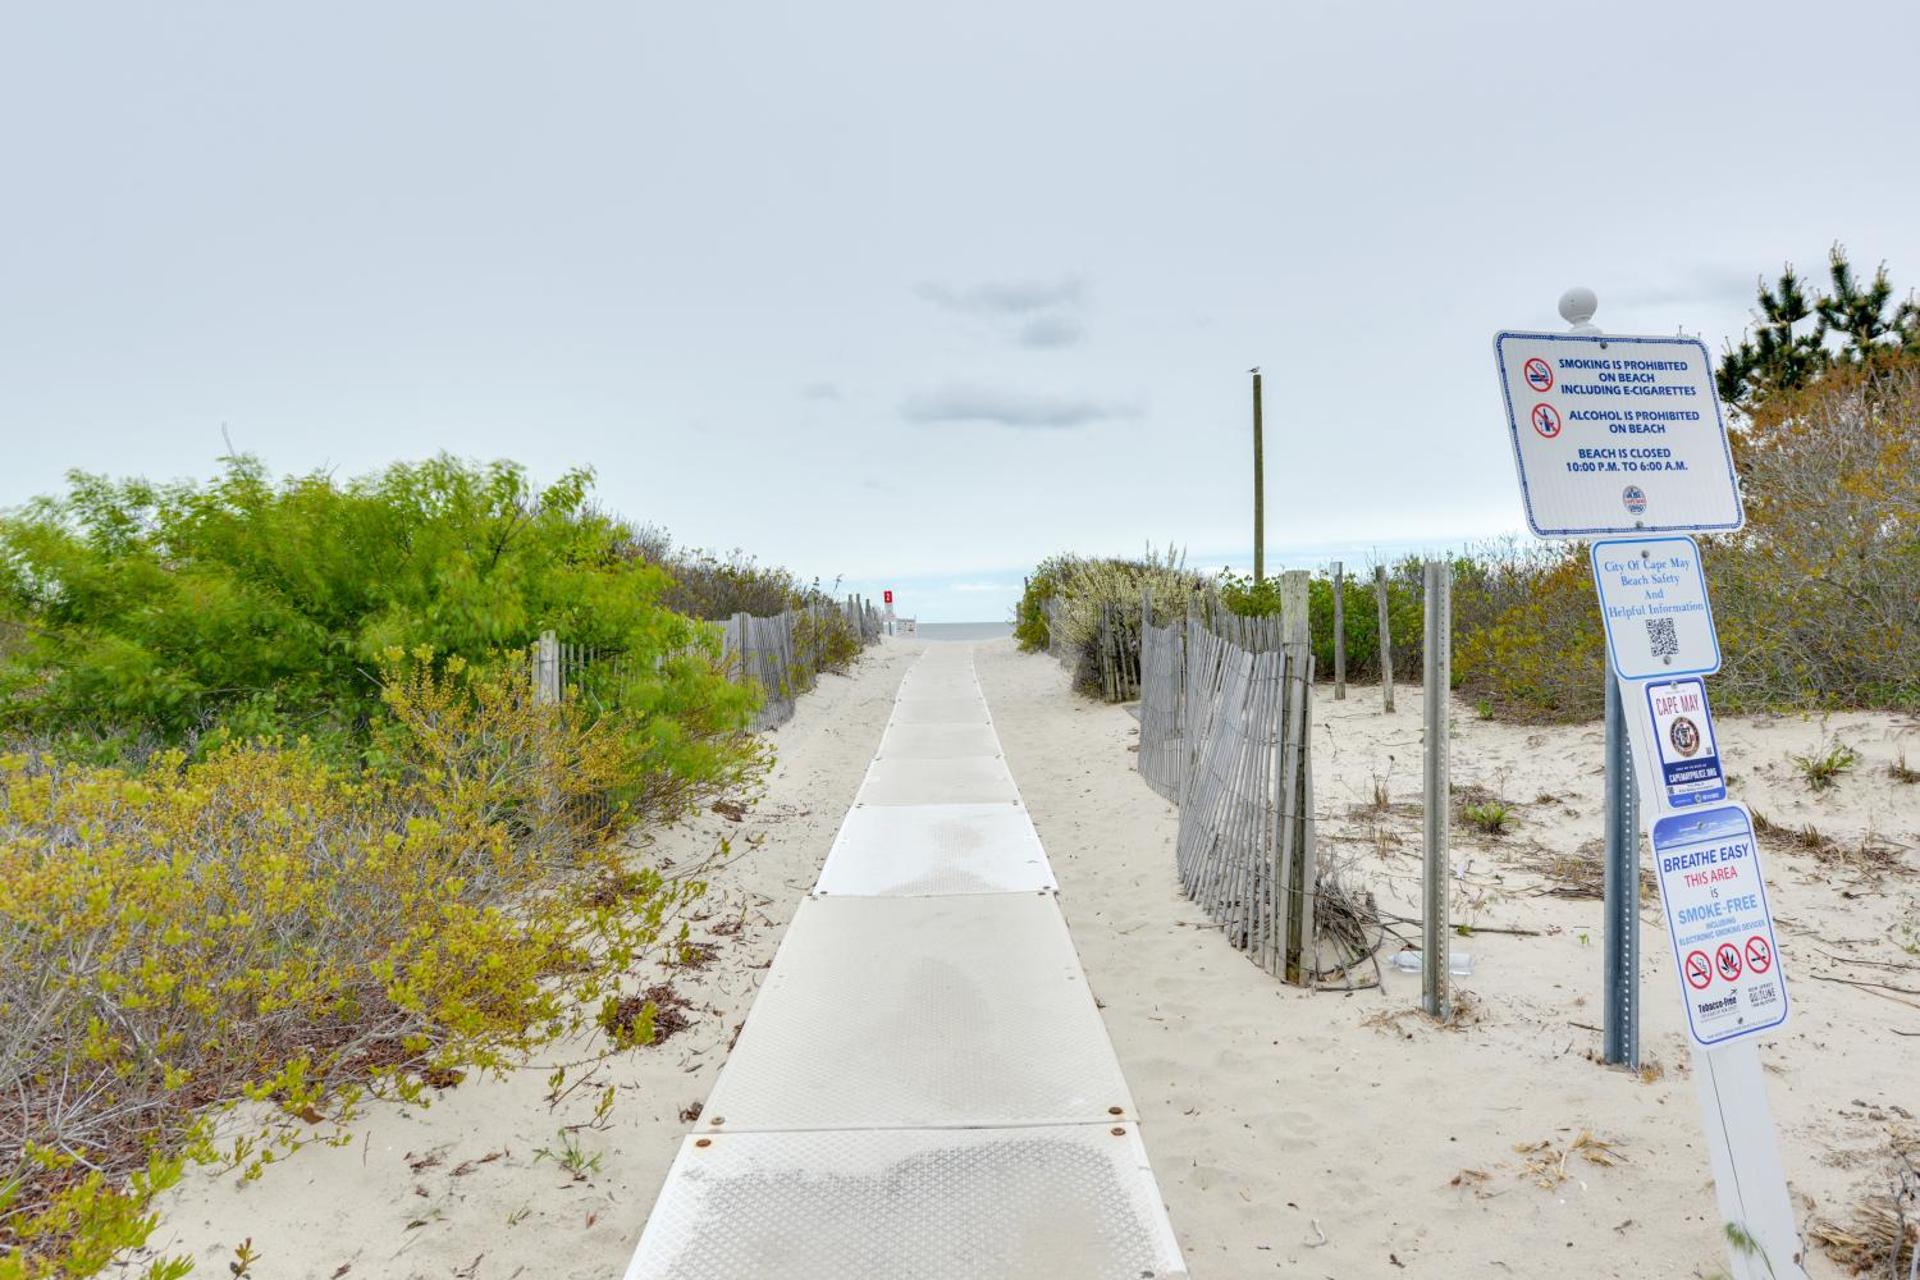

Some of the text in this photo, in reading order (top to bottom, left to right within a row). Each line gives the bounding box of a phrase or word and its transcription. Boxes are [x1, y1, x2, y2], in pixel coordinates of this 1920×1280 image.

[1559, 359, 1688, 371] SMOKING IS PROHIBITED
[1598, 373, 1655, 383] ON BEACH
[1561, 385, 1696, 396] INCLUDING E-CIGARETTES
[1569, 411, 1700, 421] ALCOHOL IS PROHIBITED
[1609, 424, 1666, 434] ON BEACH
[1578, 448, 1671, 458] BEACH IS CLOSED
[1566, 461, 1688, 472] 10:00 P.M. TO 6:00 A.M.
[1604, 557, 1690, 573] City Of Cape May
[1621, 573, 1680, 586] Beach Safety
[1645, 588, 1664, 599] And
[1608, 601, 1704, 619] Helpful Information
[1656, 694, 1699, 716] CAPE MAY
[1663, 843, 1749, 873] BREATHE EASY
[1684, 865, 1738, 888] THIS AREA
[1678, 894, 1758, 924] SMOKE-FREE
